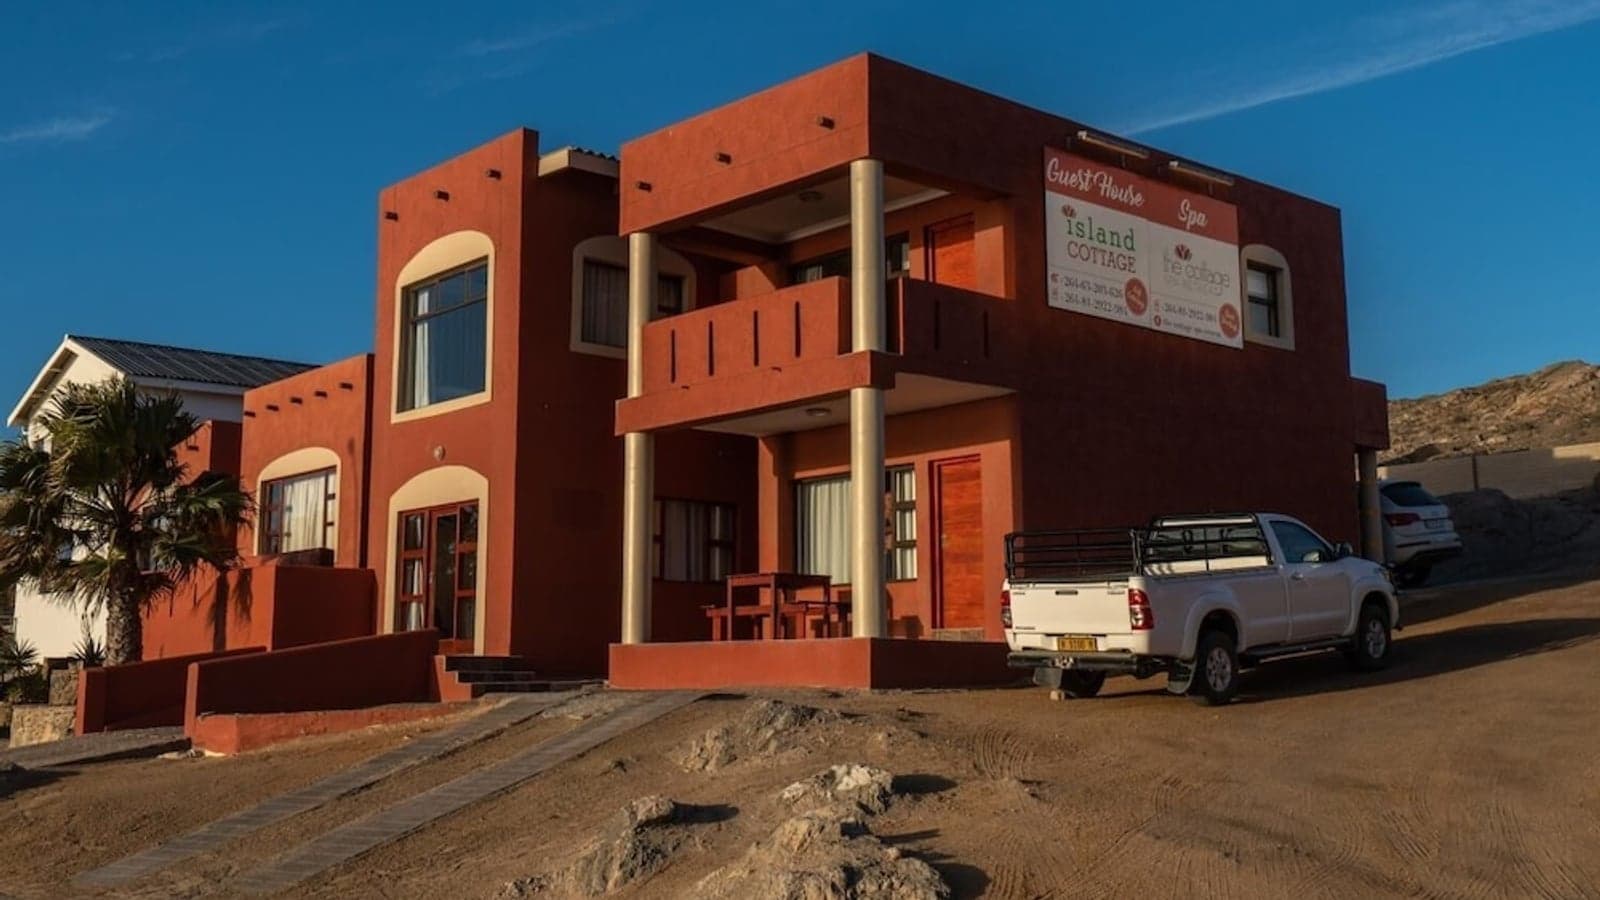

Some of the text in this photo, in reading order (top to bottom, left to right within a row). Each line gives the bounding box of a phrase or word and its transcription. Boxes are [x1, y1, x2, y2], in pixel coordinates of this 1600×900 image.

[1047, 157, 1145, 207] Guest House
[1178, 199, 1208, 229] Spa
[1066, 216, 1136, 252] island
[1067, 240, 1136, 273] COTTAGE
